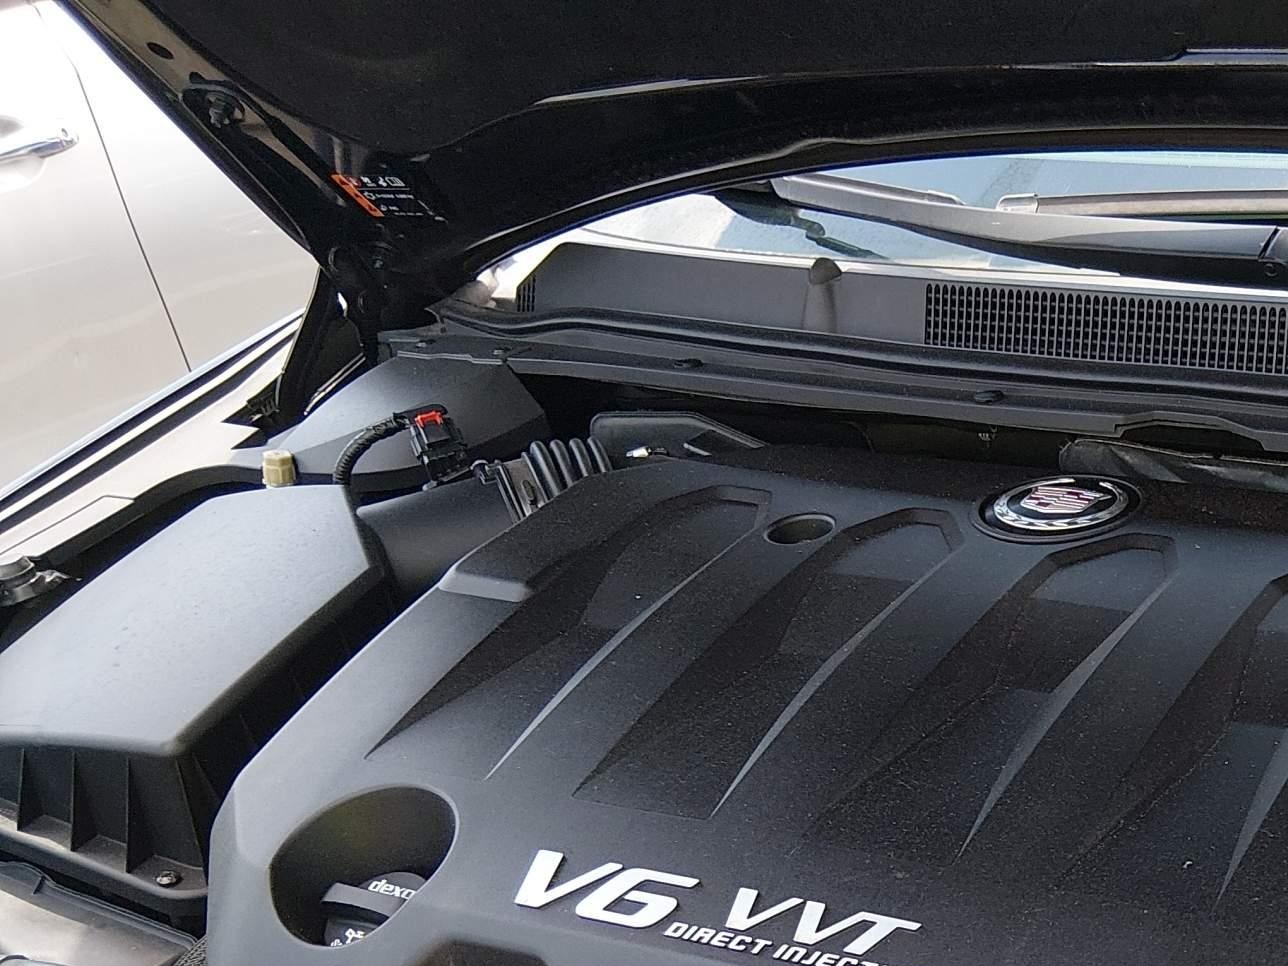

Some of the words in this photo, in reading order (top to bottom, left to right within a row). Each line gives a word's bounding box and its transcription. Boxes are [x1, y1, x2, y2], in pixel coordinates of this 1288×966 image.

[513, 849, 700, 929] V6
[725, 887, 922, 955] VVT
[663, 921, 772, 956] DIRECT
